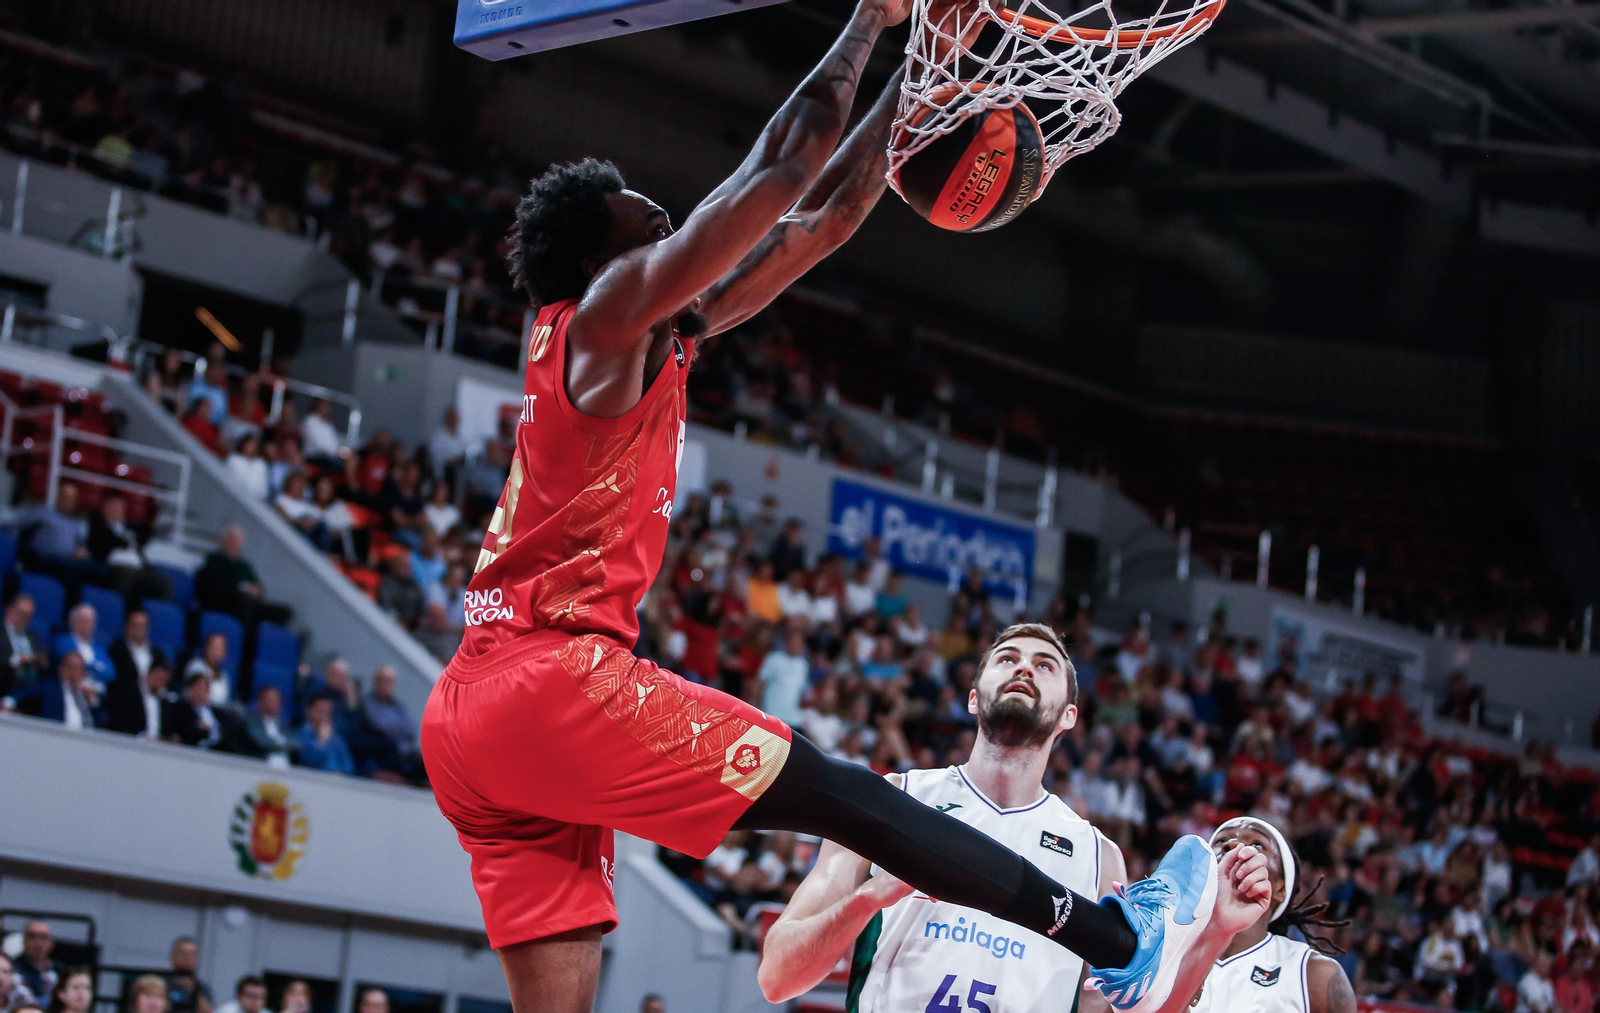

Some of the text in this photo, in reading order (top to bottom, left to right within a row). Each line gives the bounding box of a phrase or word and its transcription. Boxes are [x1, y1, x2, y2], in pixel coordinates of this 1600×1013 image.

[480, 6, 522, 24] MONDO
[955, 148, 1006, 223] LEGACY
[924, 974, 997, 1013] 45
